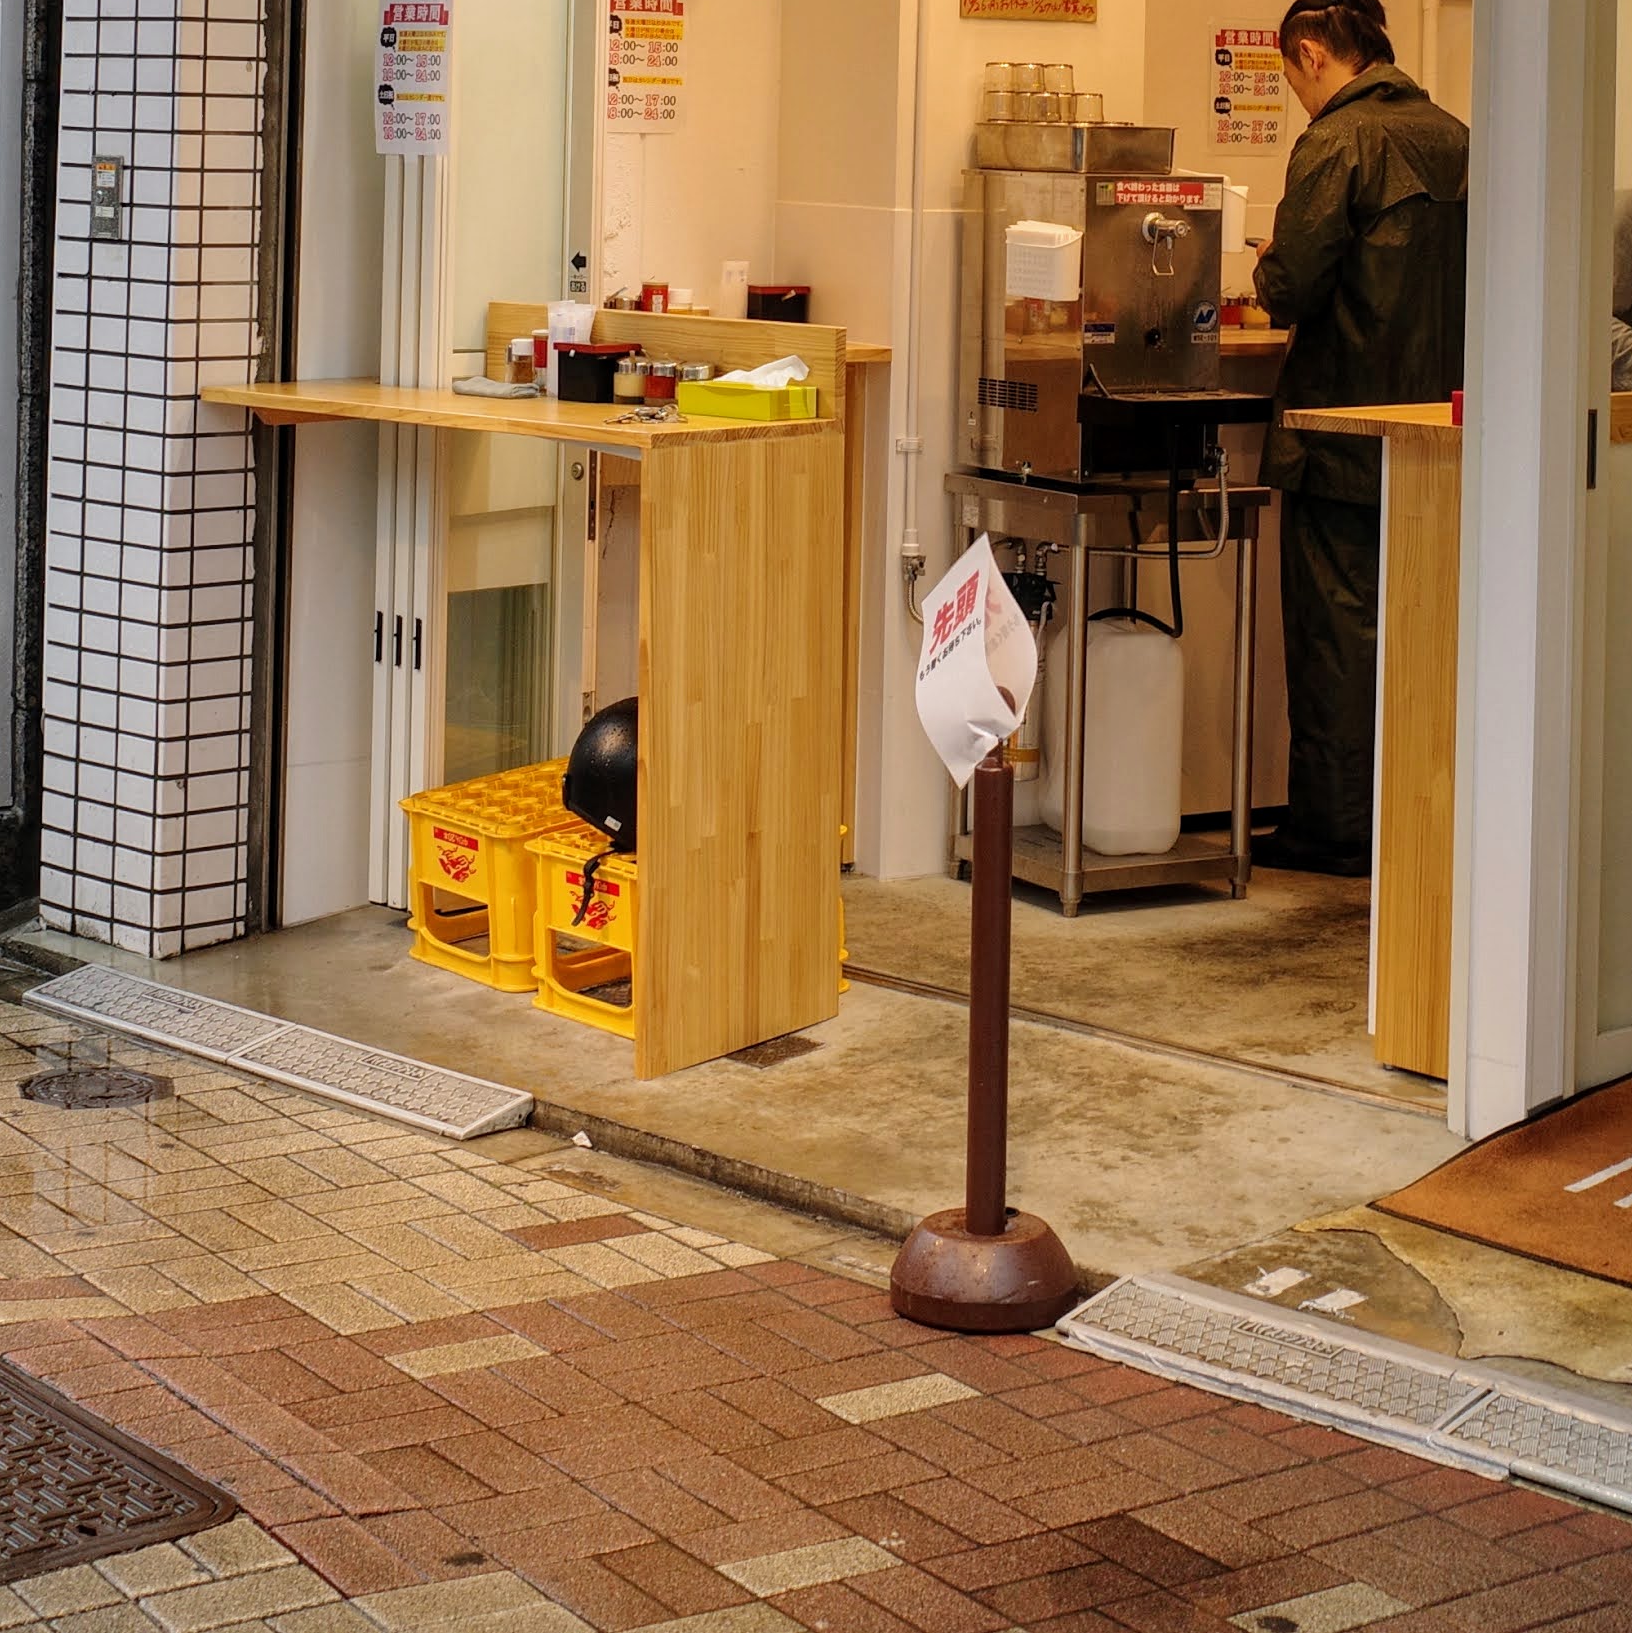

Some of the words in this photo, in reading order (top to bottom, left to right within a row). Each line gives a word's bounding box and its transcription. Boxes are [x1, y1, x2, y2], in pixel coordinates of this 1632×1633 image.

[392, 5, 442, 22] 営業時間
[1224, 30, 1275, 46] 営業時間
[929, 568, 980, 656] 先頭
